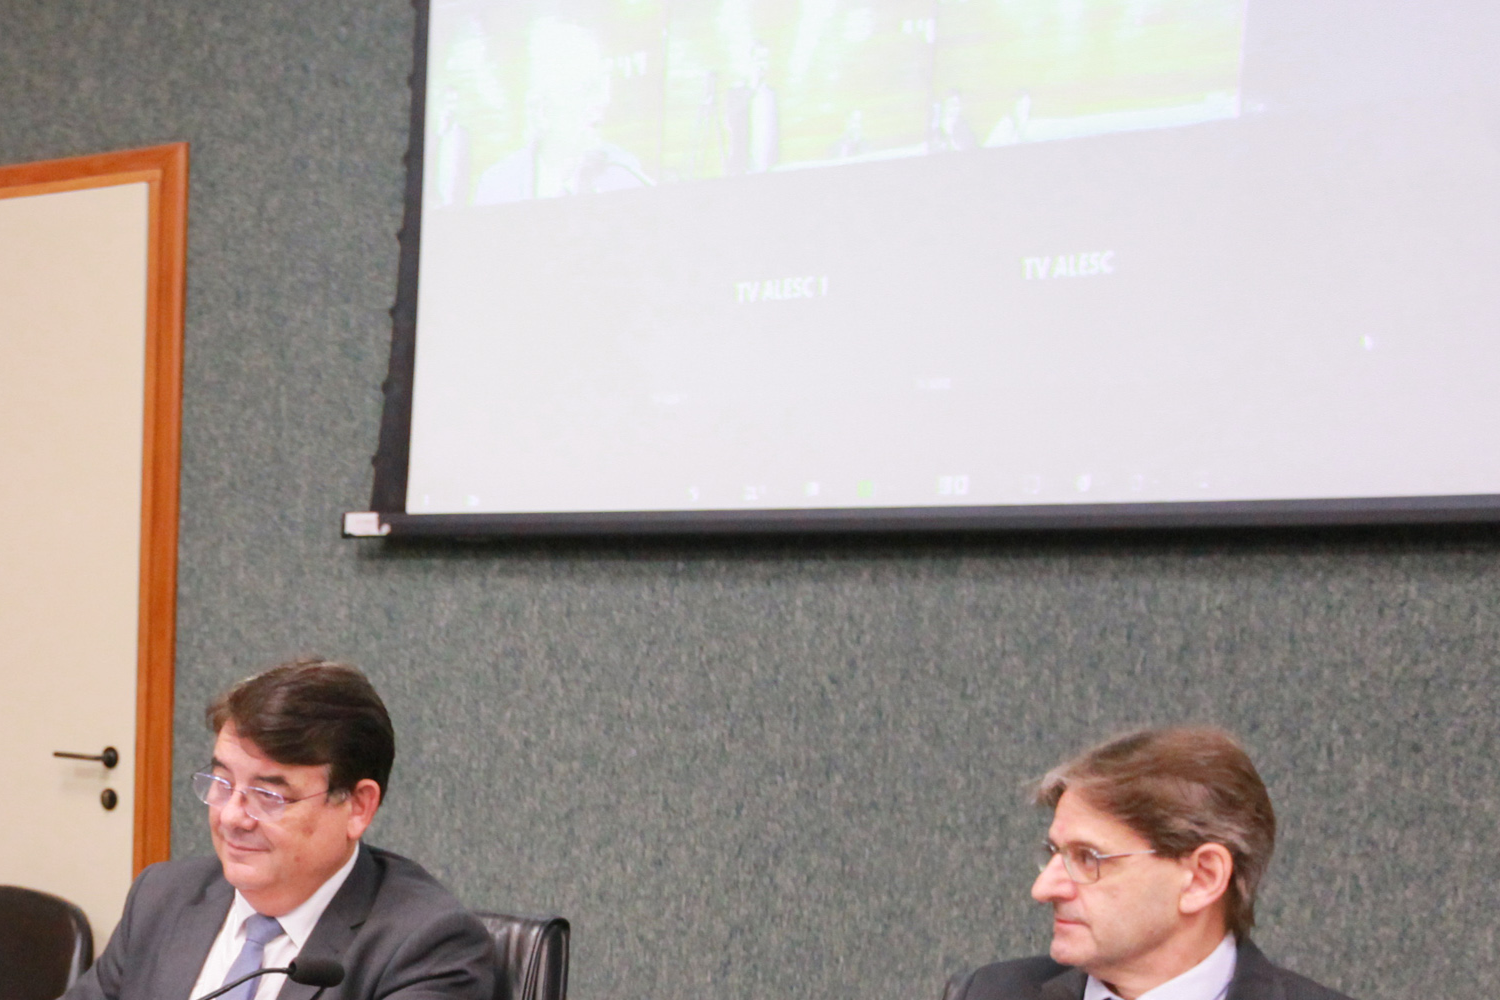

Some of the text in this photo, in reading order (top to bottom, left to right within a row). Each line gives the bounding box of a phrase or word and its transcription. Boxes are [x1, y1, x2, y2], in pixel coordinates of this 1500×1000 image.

[1020, 250, 1115, 280] TV ALESC
[733, 275, 828, 303] TV ALESC 1
